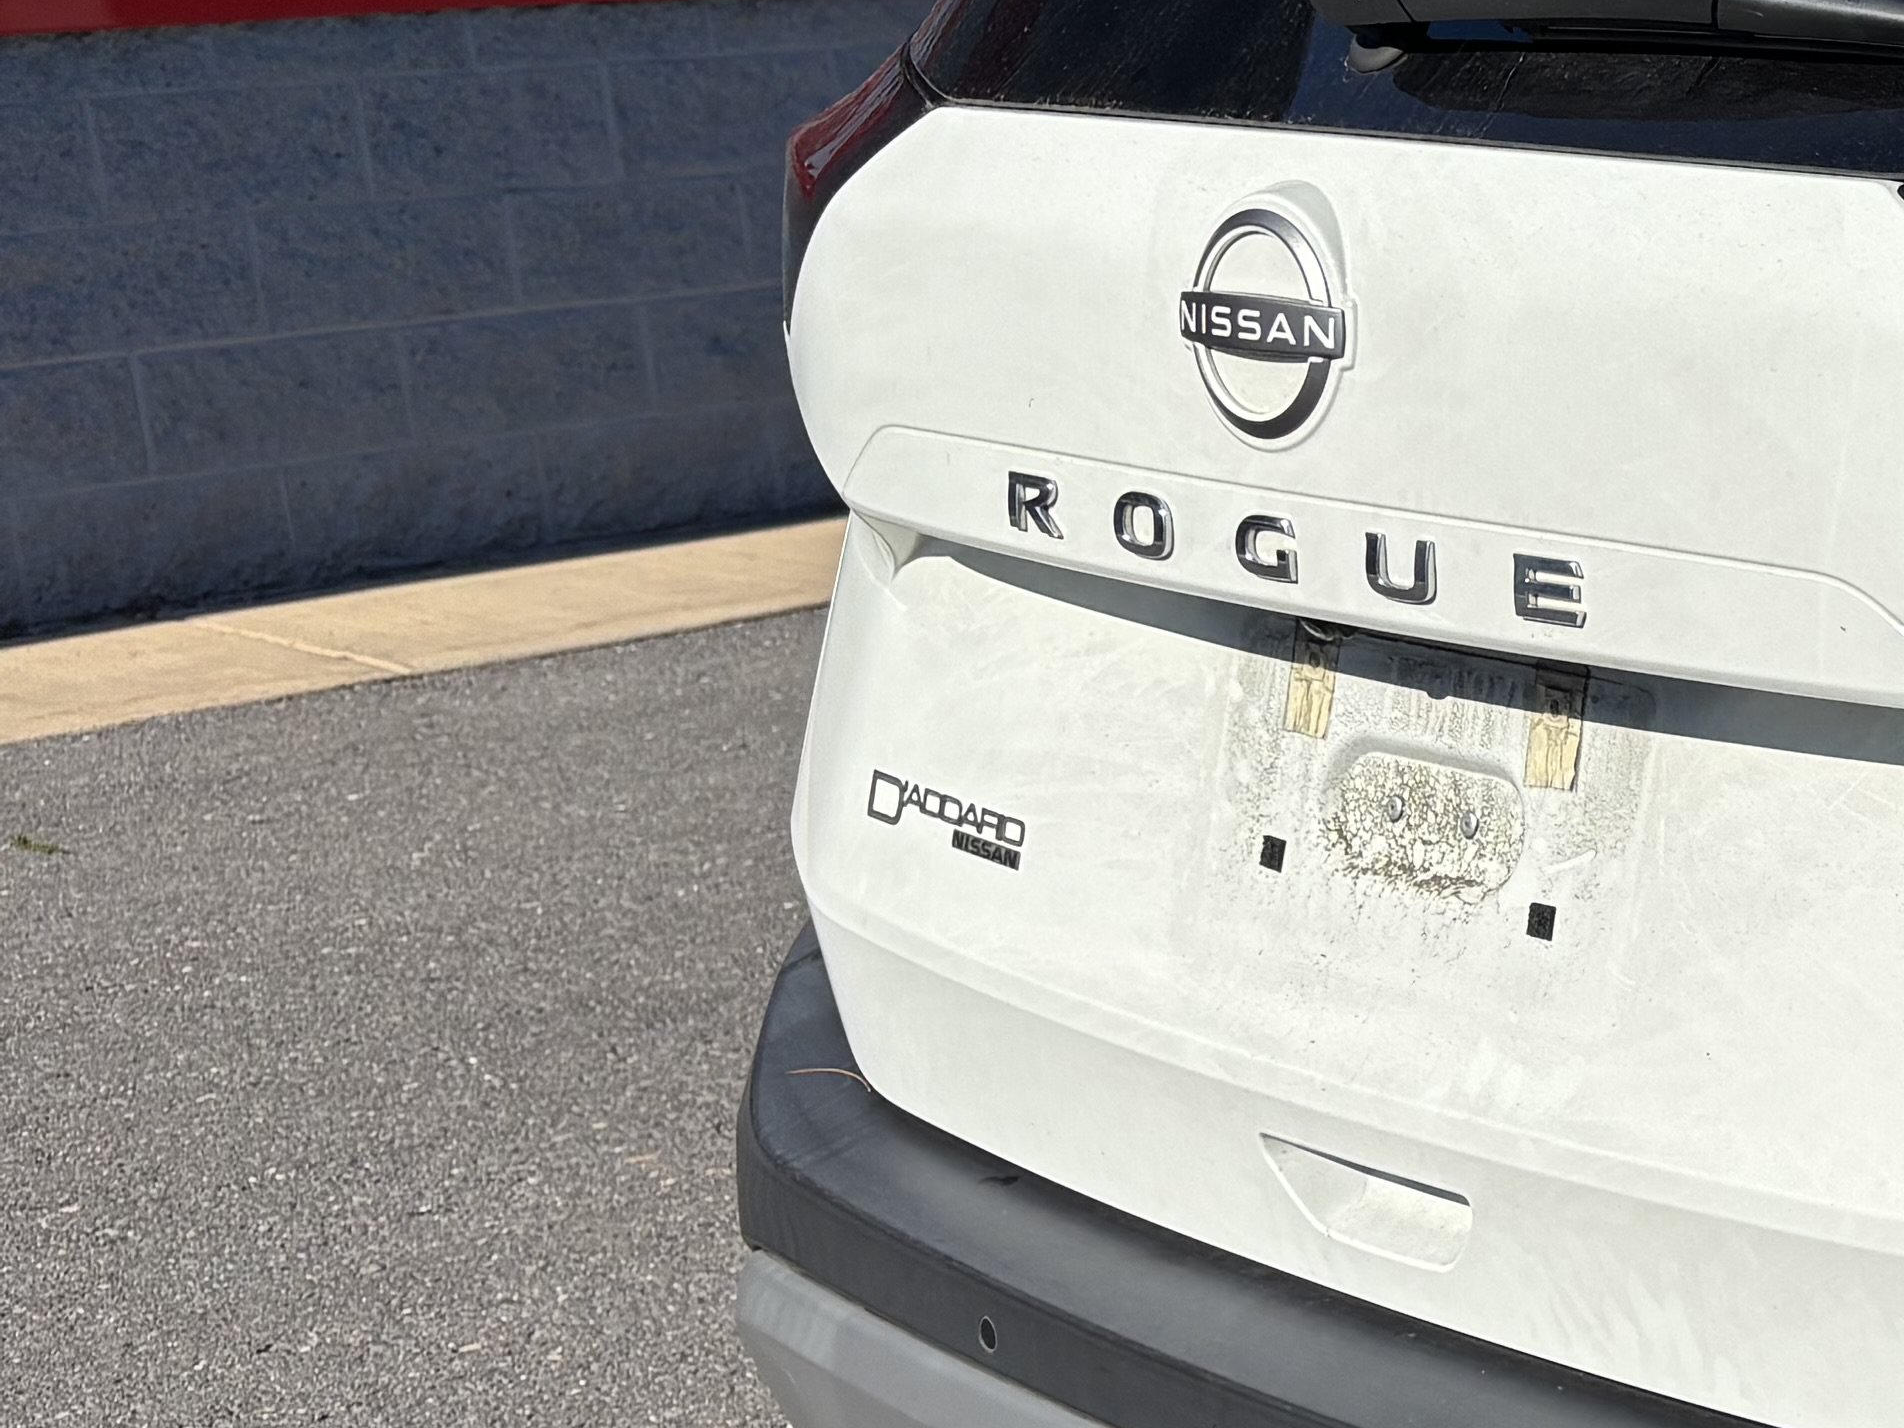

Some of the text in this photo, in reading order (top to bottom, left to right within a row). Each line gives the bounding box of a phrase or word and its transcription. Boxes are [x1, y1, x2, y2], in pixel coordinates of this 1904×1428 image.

[1181, 299, 1335, 349] NISSAN
[1008, 471, 1588, 628] ROGUE
[951, 828, 1021, 871] NISSAN
